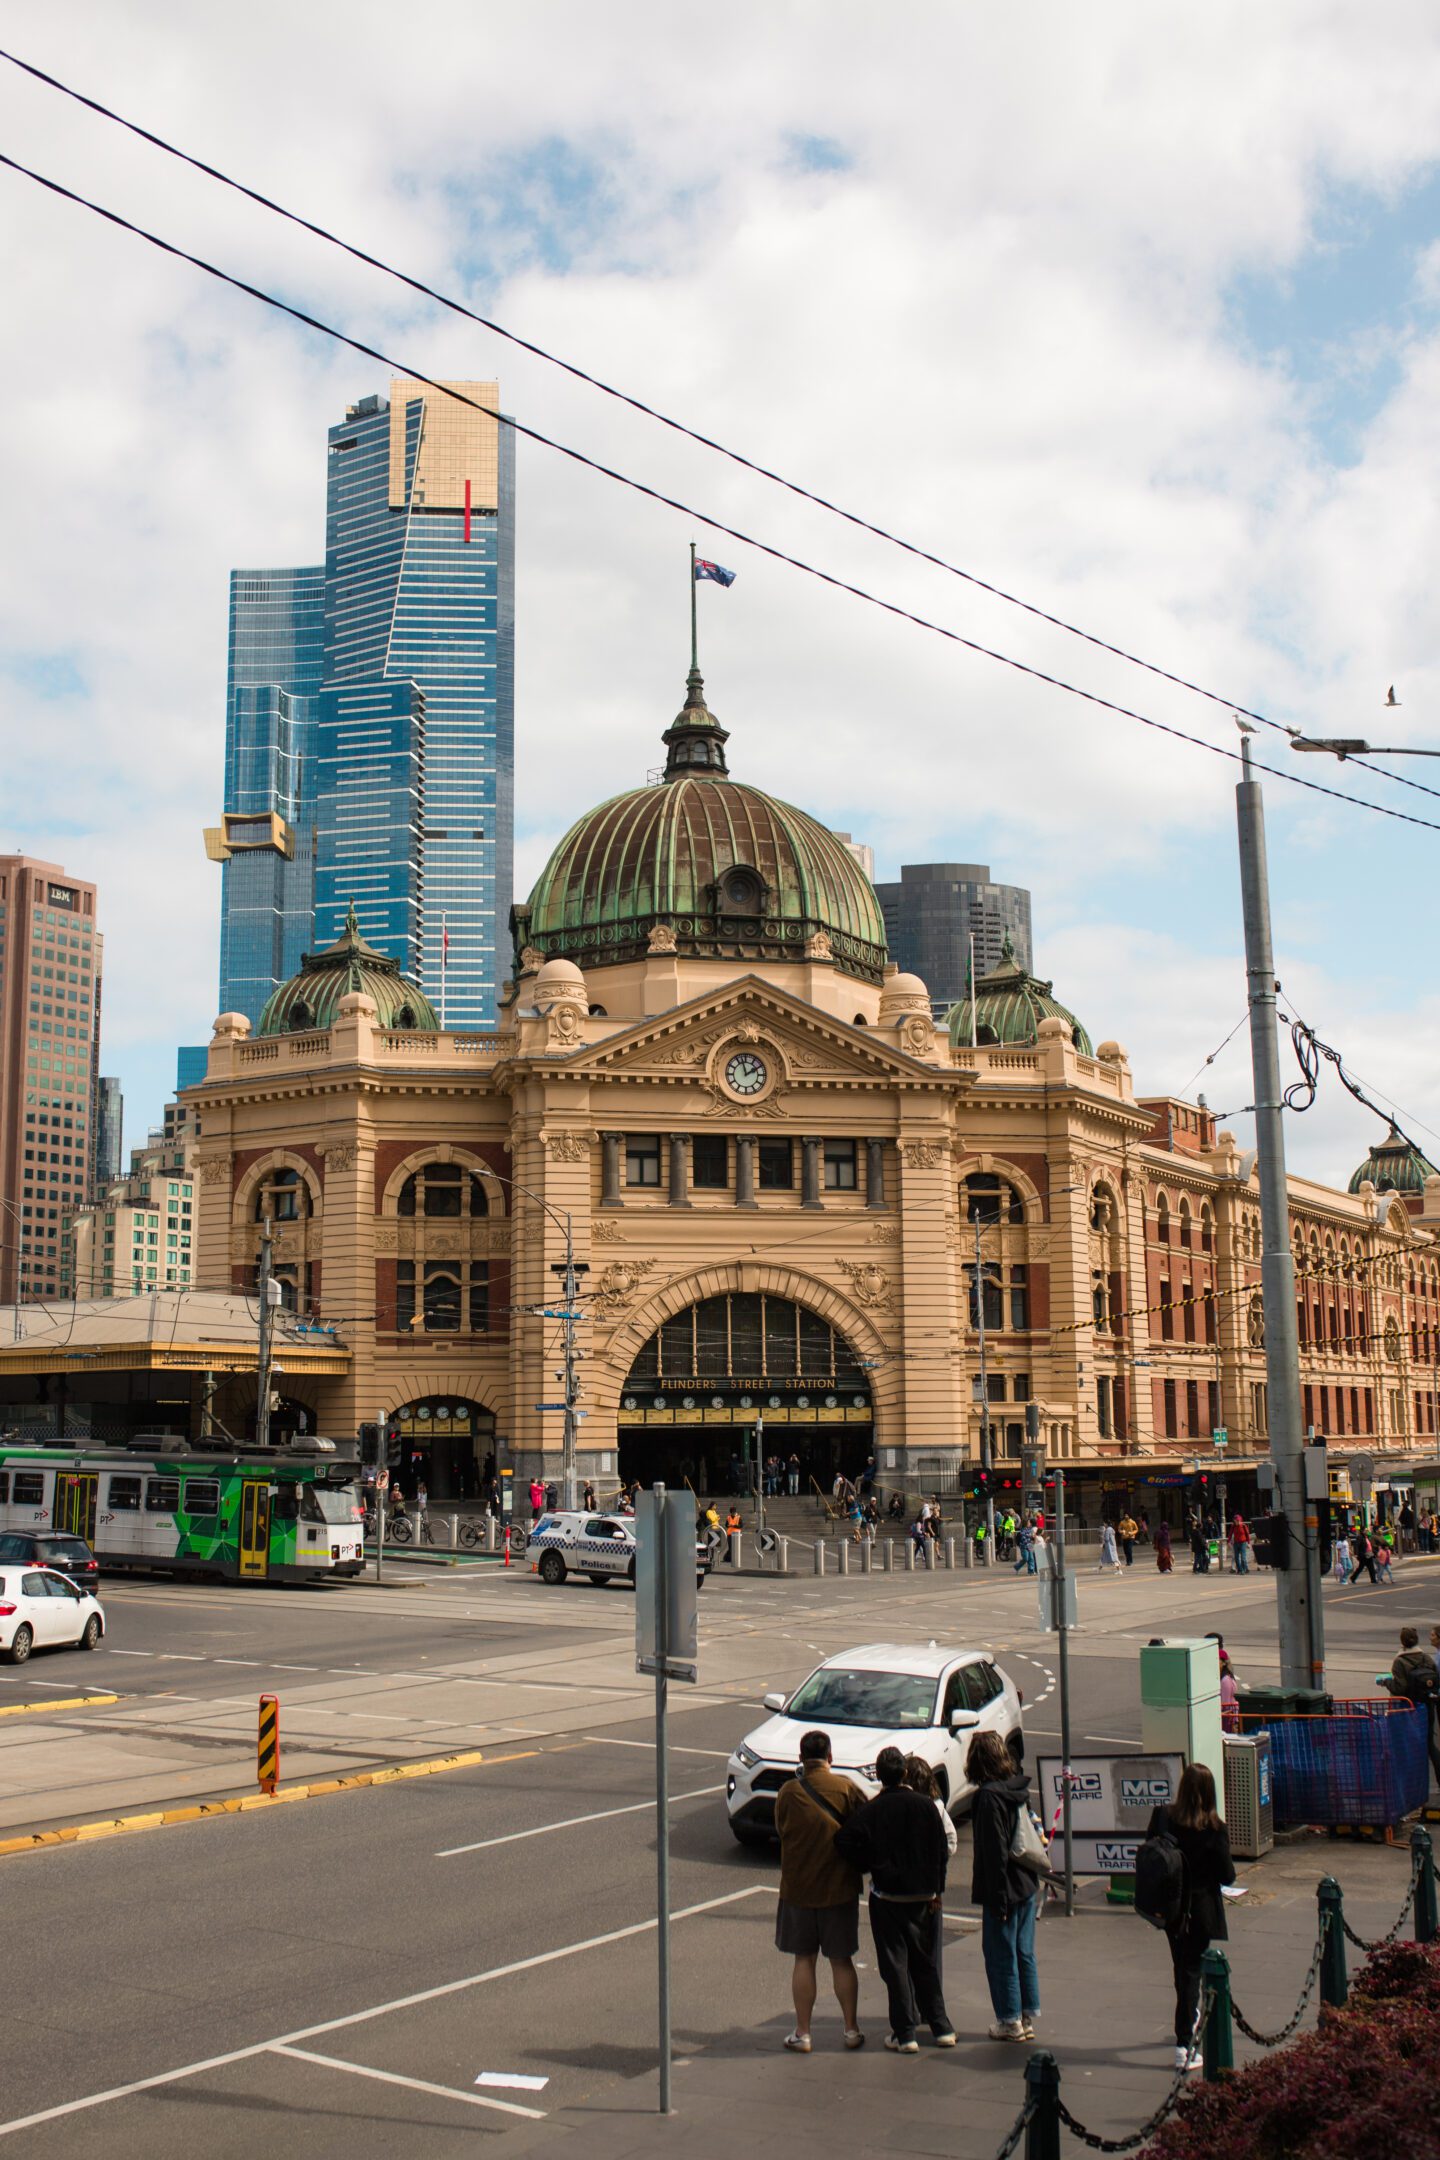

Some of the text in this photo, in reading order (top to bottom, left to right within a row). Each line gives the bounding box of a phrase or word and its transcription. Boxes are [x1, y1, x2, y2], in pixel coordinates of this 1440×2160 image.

[51, 888, 70, 902] IBM
[661, 1379, 835, 1389] FLINDERS STREET STATION
[581, 1559, 611, 1569] Police
[1121, 1780, 1170, 1796] MC
[1056, 1792, 1102, 1800] TAFFIC
[1096, 1844, 1138, 1860] MC
